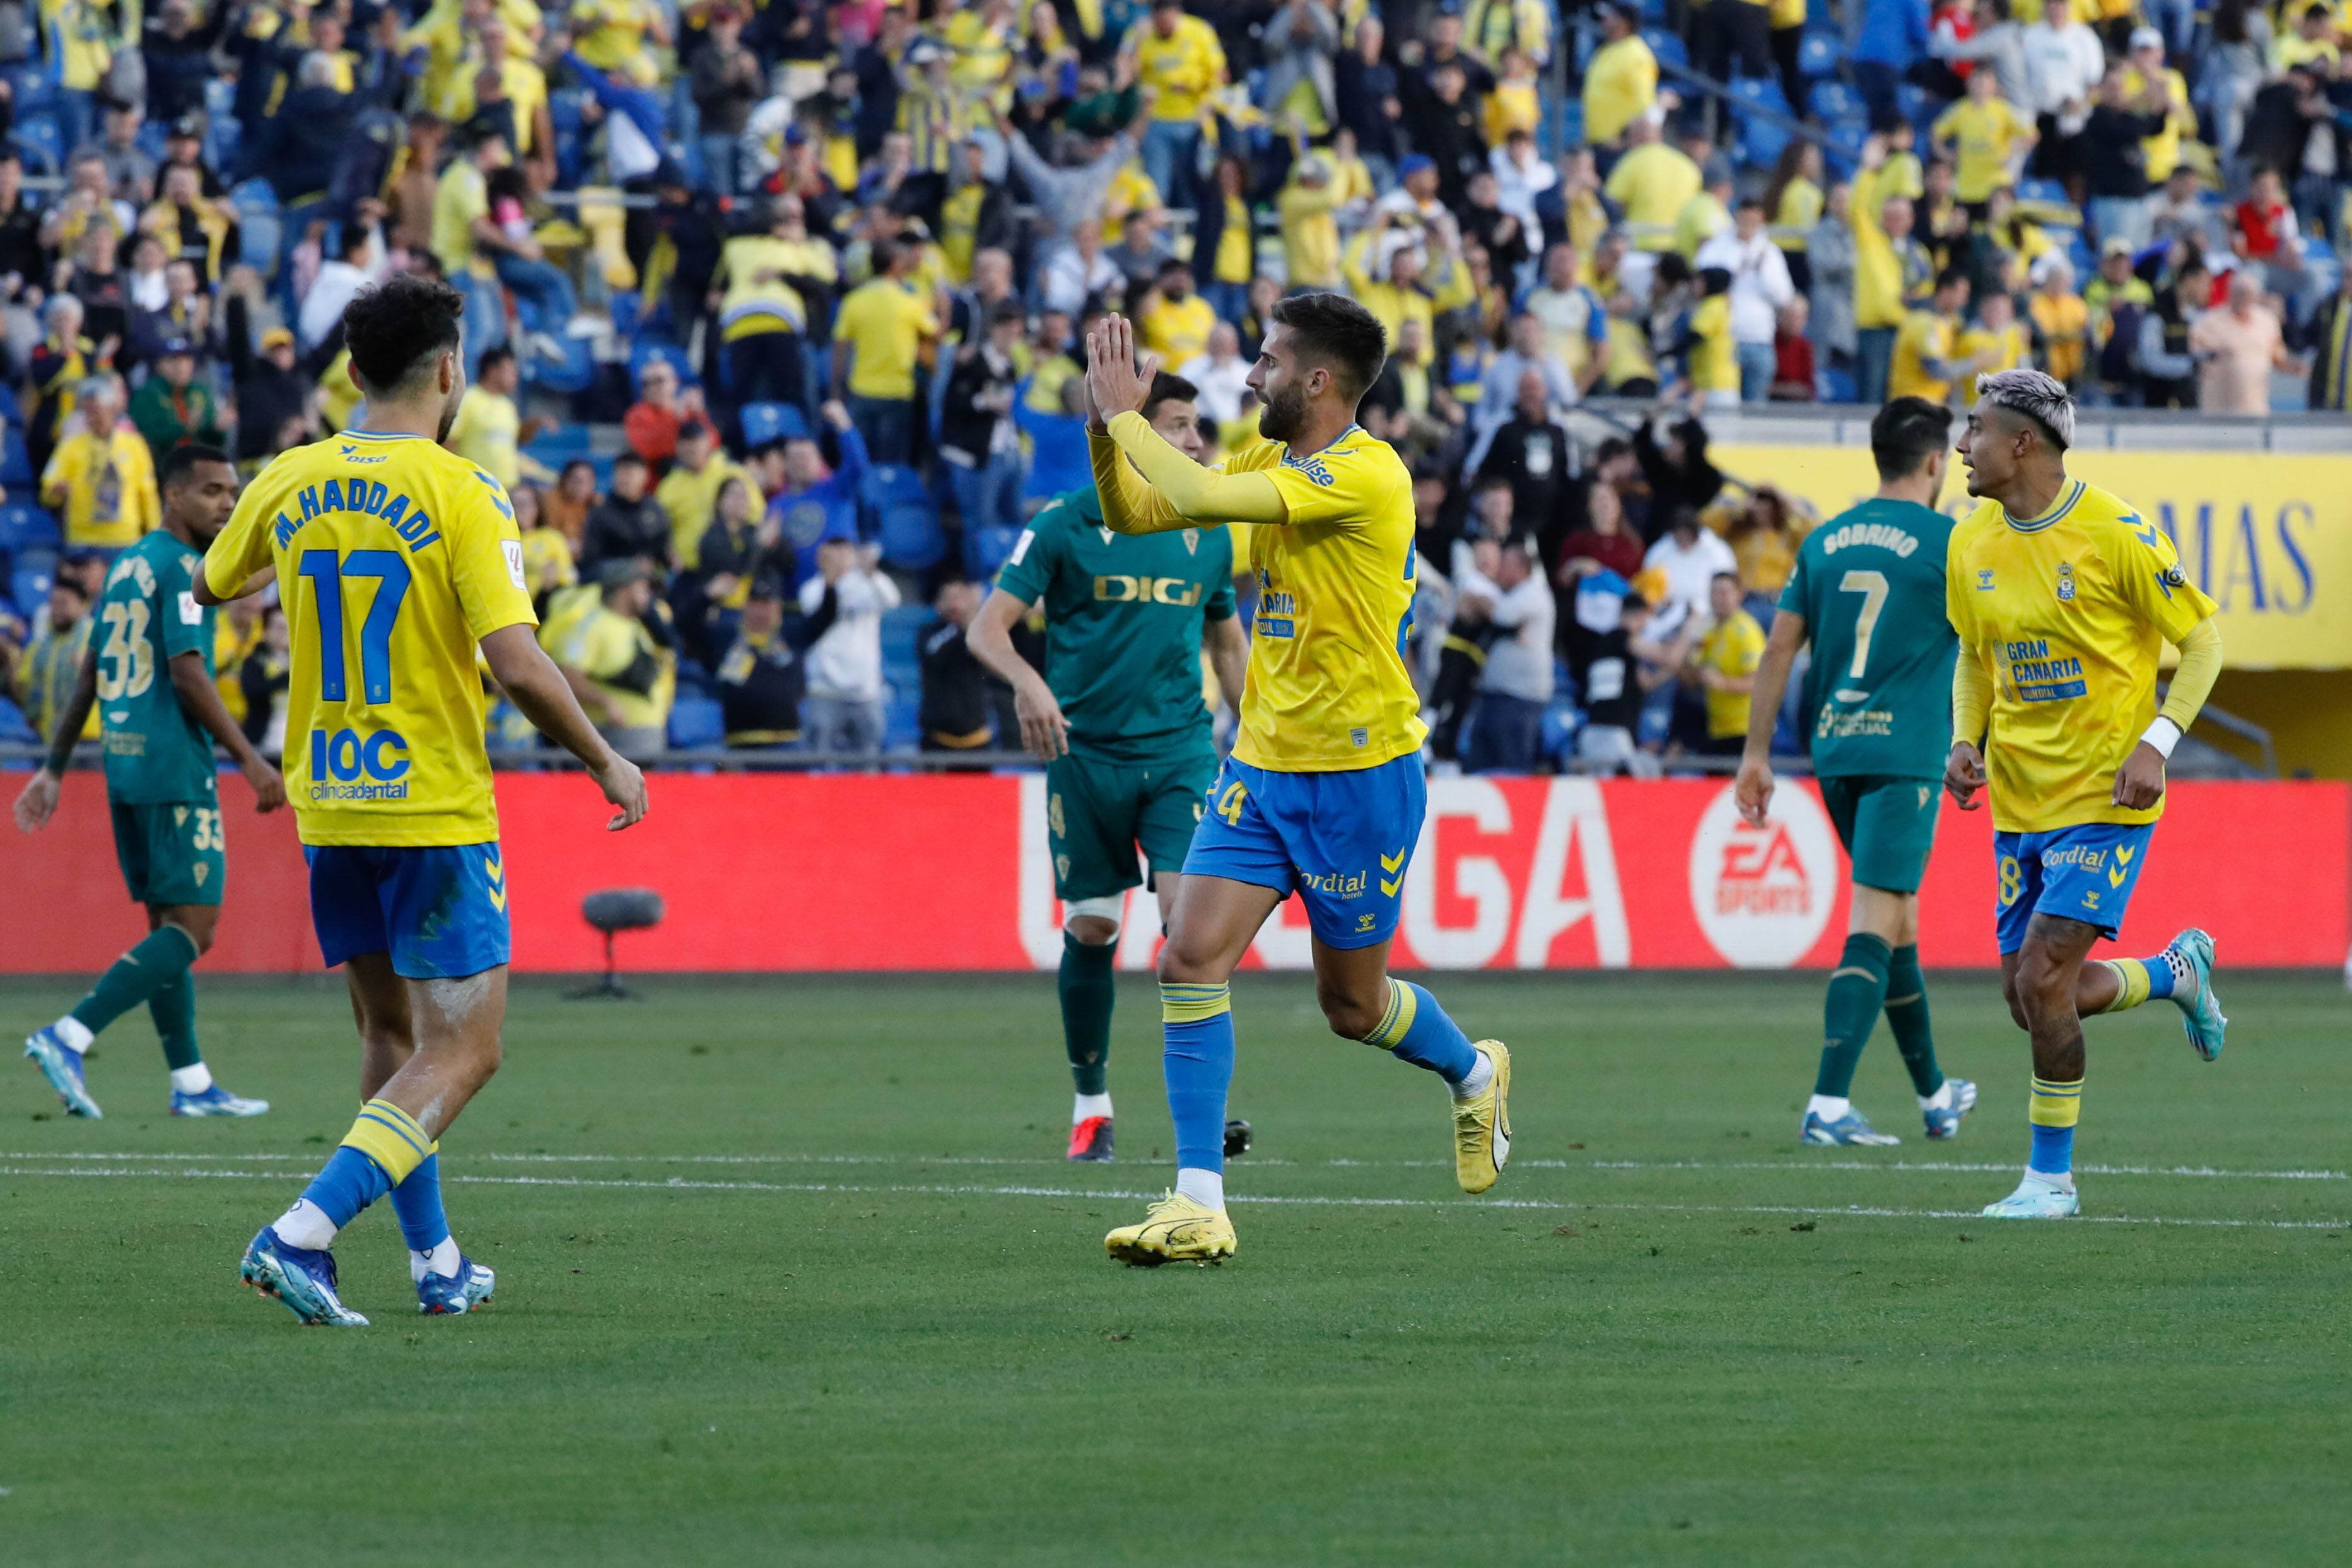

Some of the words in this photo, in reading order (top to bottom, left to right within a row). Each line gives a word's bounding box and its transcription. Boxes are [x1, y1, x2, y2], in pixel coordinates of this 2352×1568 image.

[274, 478, 441, 553] M.HADDADI
[1823, 523, 1919, 558] SOBRINO
[2157, 500, 2317, 619] MAS
[1094, 575, 1202, 607] DIGI
[298, 549, 411, 705] 17
[1838, 570, 1890, 679] 7
[97, 599, 155, 701] 33
[2007, 639, 2049, 660] GRAN
[2012, 657, 2083, 682] CANARIA
[2021, 686, 2058, 699] MUNDIAL
[312, 728, 411, 781] IOC
[1721, 821, 1808, 879] EA
[2041, 845, 2108, 868] Cordial
[1297, 868, 1367, 893] ordial
[1342, 891, 1363, 901] hotels
[1999, 855, 2022, 906] 8
[1716, 885, 1809, 915] SPORTS
[1355, 923, 1376, 933] hummel
